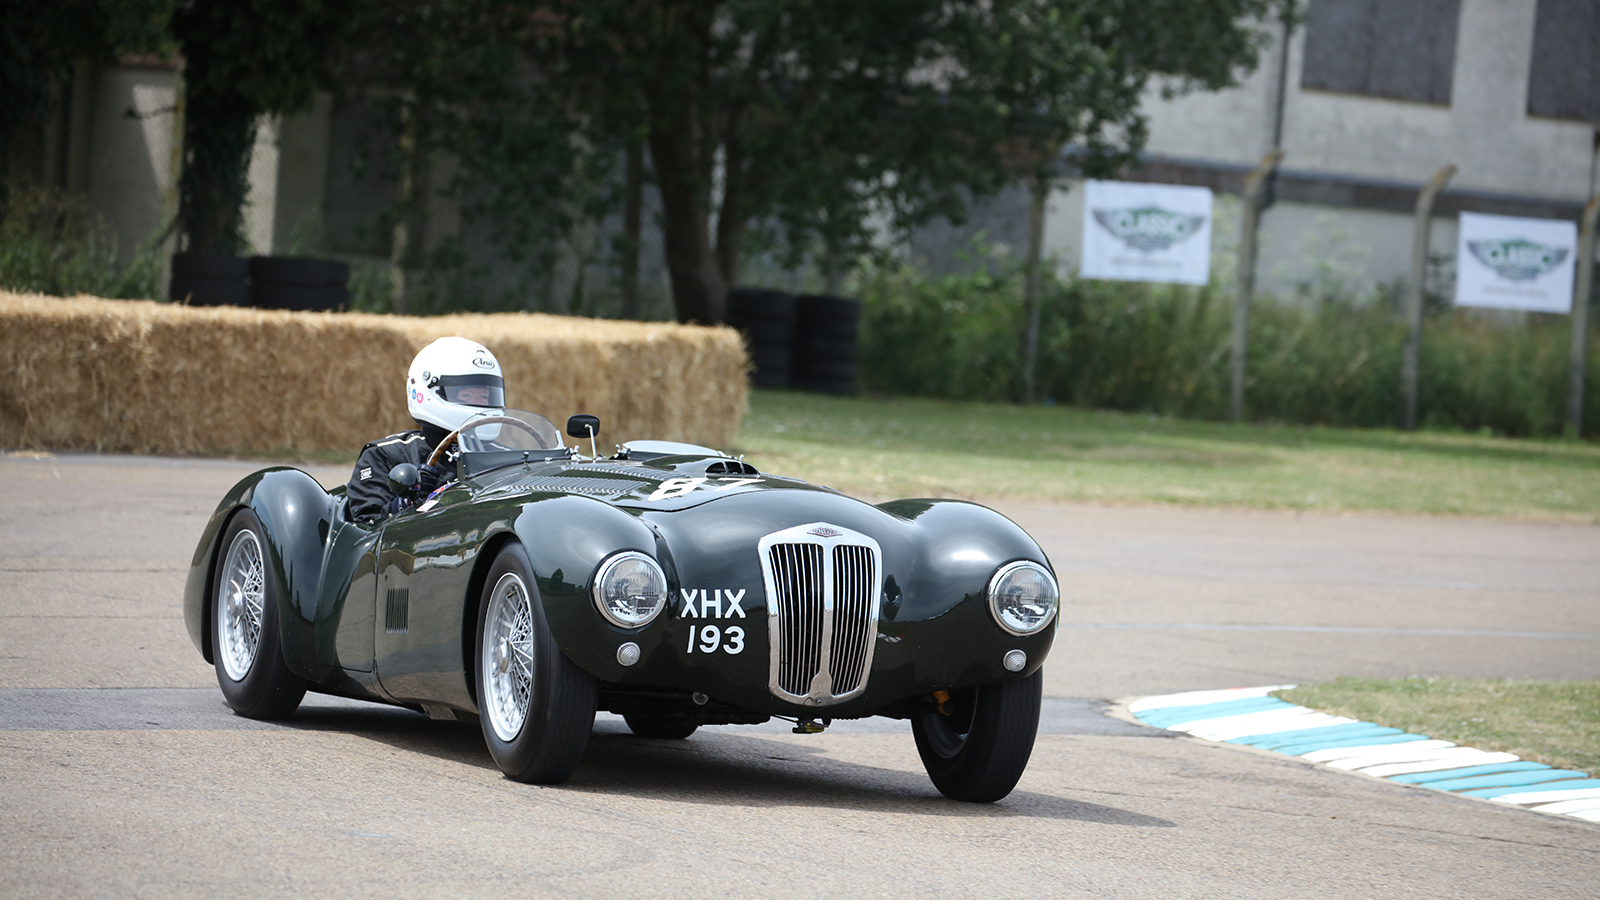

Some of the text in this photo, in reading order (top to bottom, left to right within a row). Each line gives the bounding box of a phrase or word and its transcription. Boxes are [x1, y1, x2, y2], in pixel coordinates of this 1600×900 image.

[648, 477, 766, 501] 87
[680, 588, 746, 619] XHX
[686, 624, 746, 655] 193
